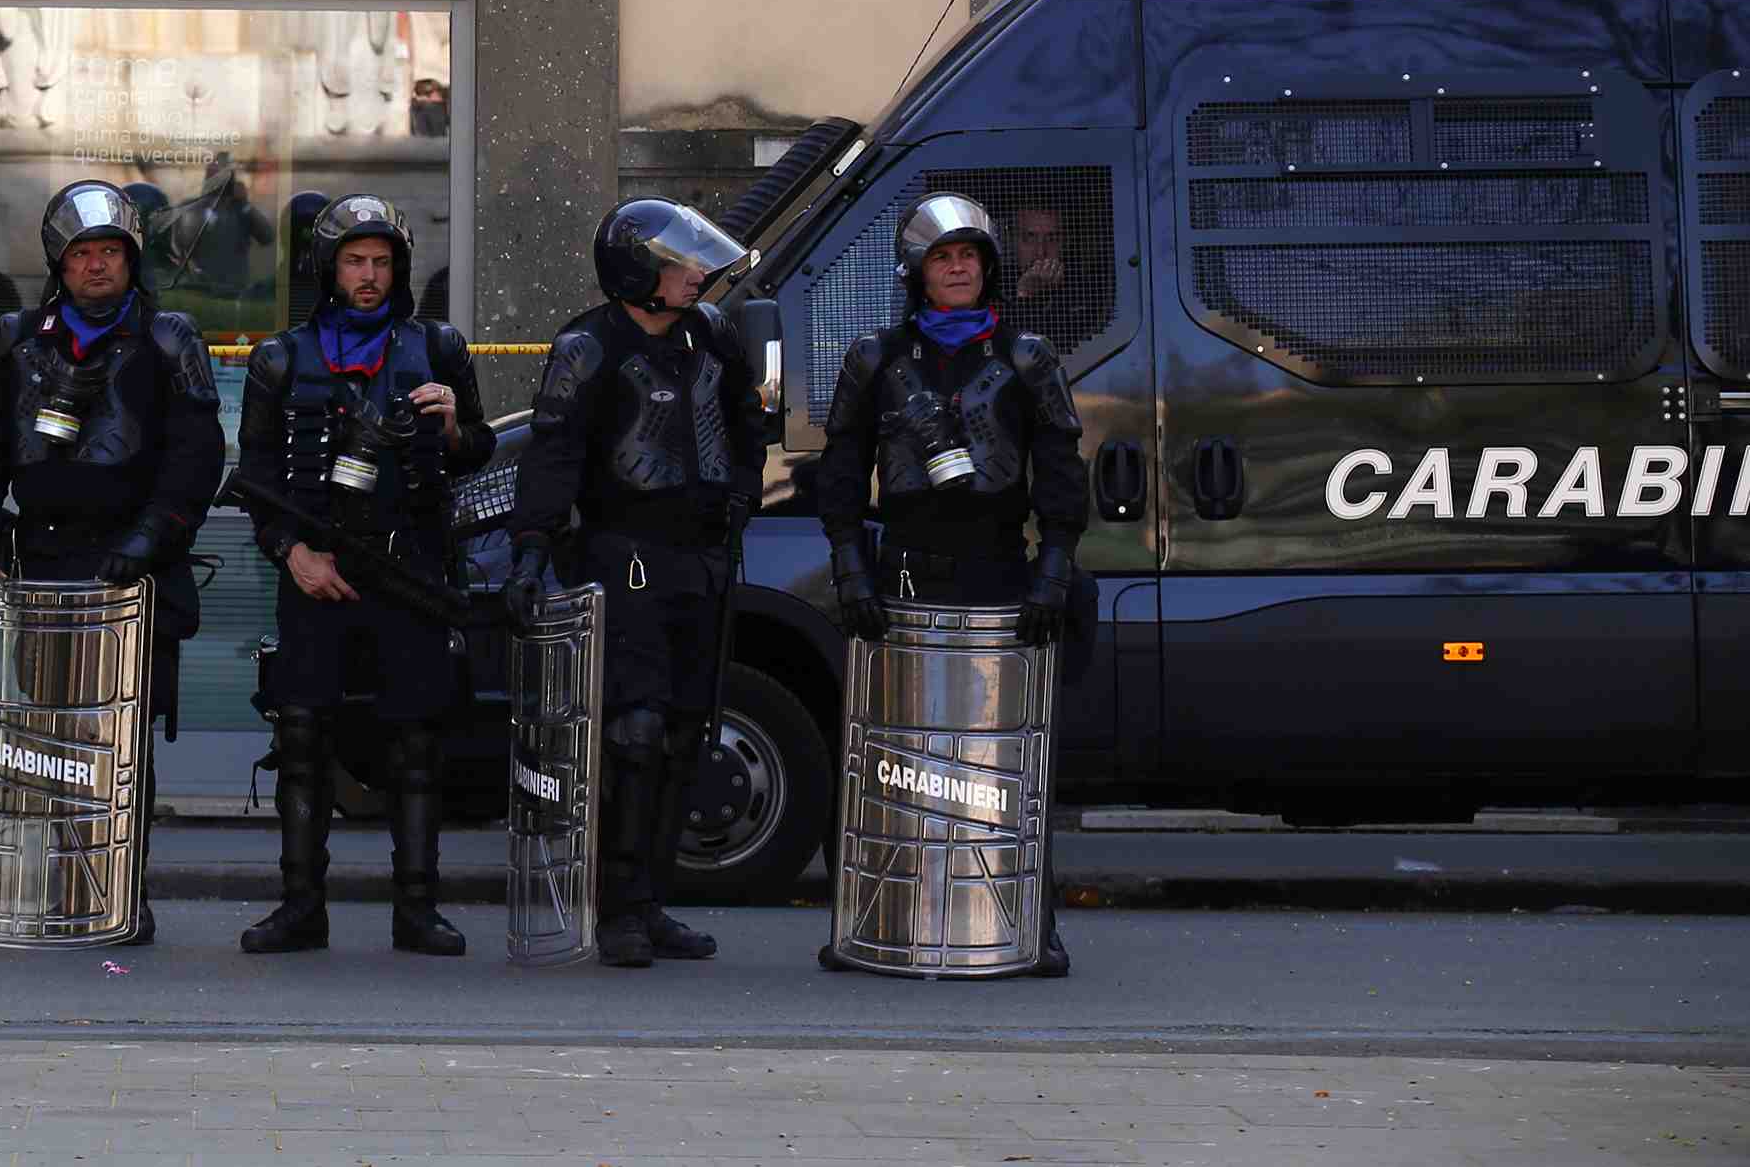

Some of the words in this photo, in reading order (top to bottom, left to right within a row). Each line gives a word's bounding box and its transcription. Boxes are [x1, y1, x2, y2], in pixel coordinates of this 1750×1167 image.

[73, 130, 131, 146] prima
[137, 126, 155, 145] di
[164, 127, 242, 146] vendere
[73, 146, 134, 167] quella
[877, 759, 1008, 812] CARABINIERI
